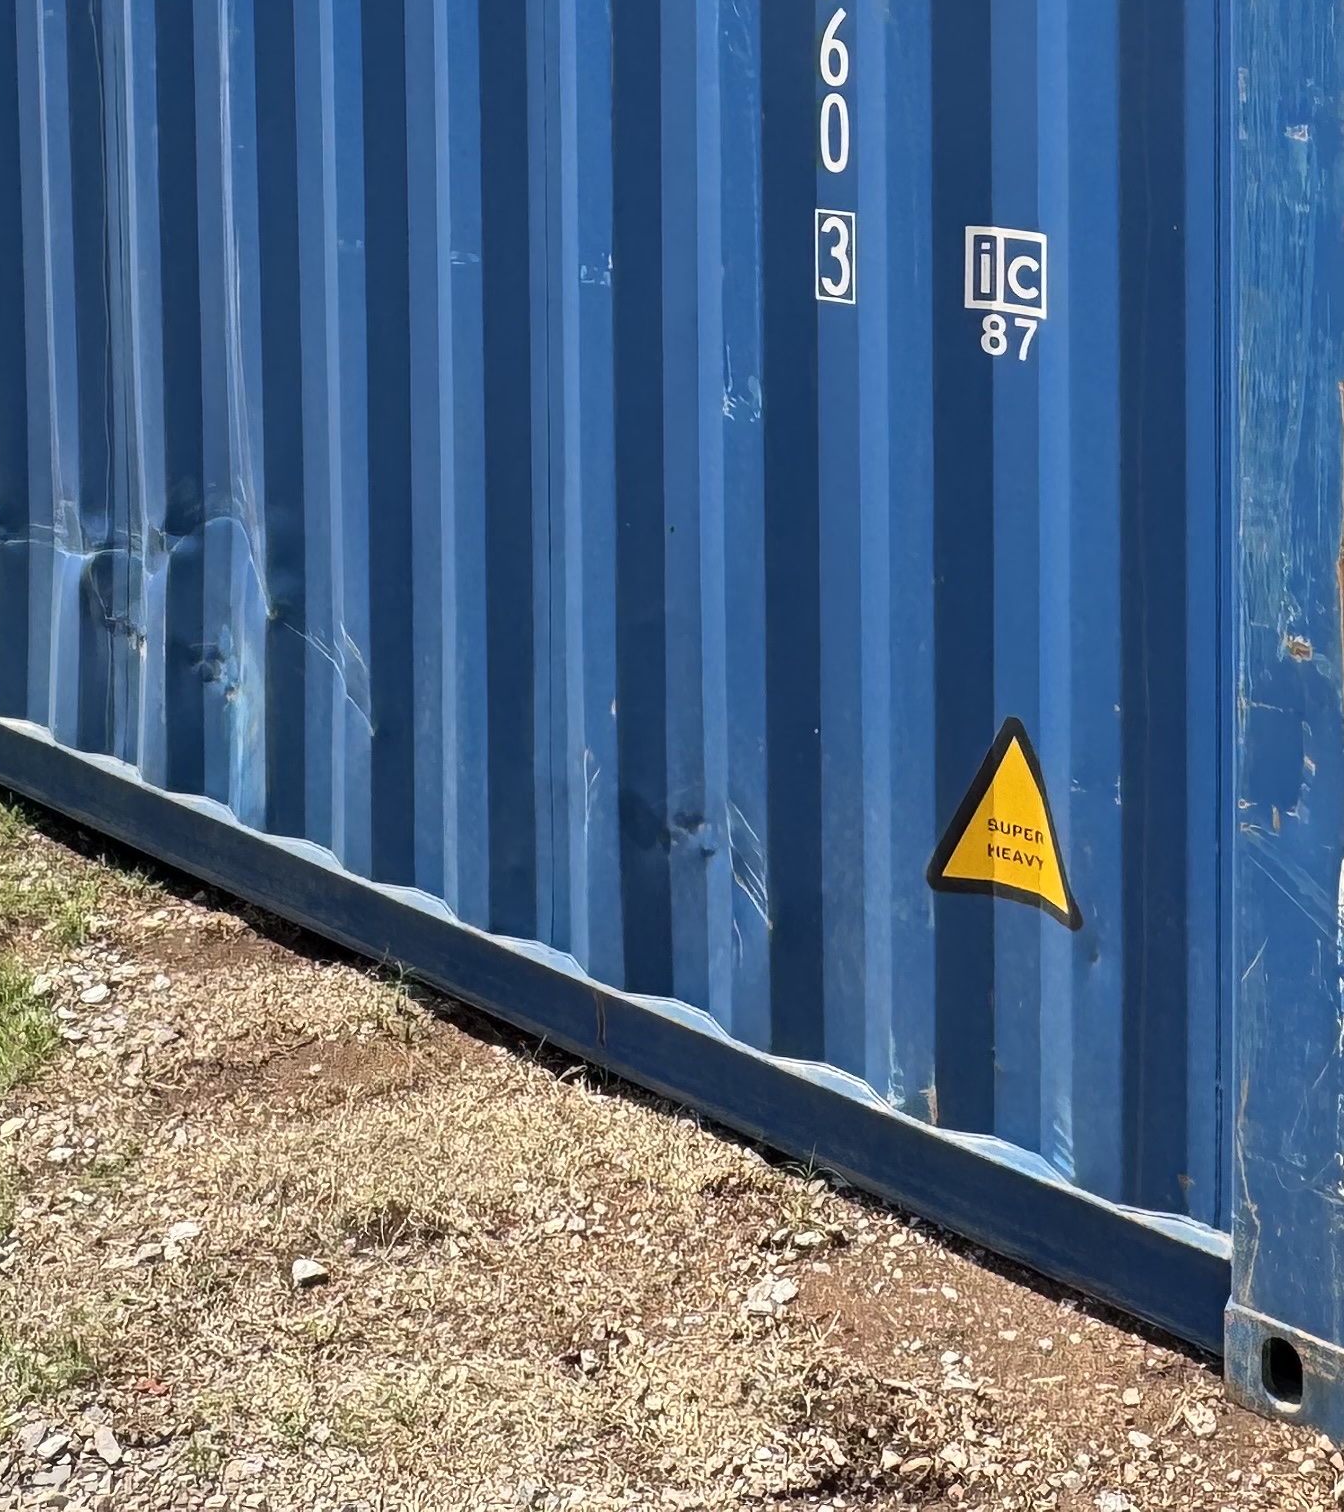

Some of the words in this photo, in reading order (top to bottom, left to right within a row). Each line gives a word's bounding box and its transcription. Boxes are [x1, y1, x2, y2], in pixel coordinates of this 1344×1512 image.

[980, 314, 1038, 361] 87
[988, 818, 1044, 845] SUPER
[987, 843, 1044, 871] HEAVY
